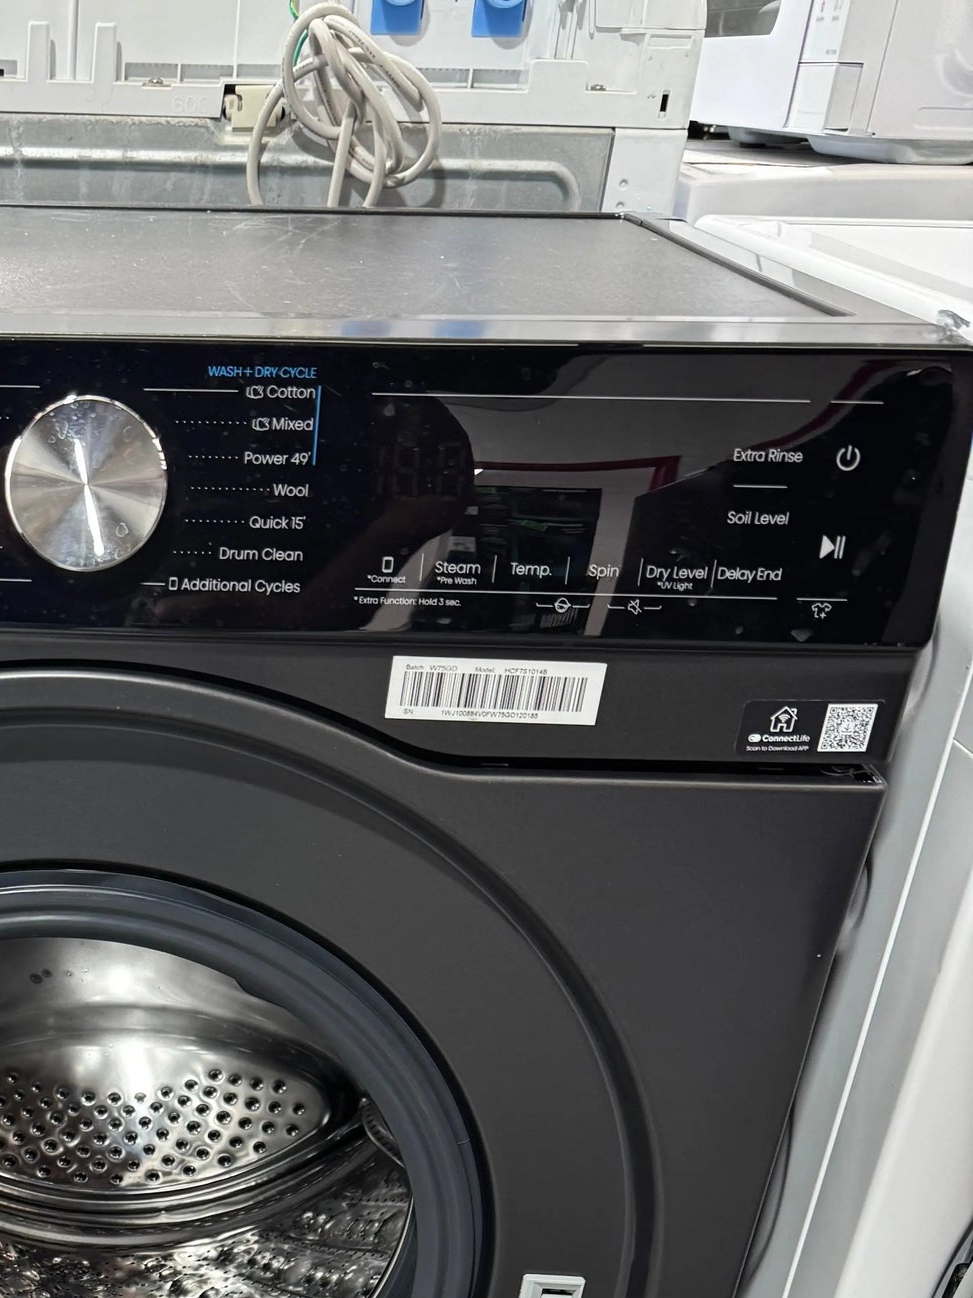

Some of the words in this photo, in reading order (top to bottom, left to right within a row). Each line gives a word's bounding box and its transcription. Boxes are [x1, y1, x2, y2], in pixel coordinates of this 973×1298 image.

[280, 367, 318, 379] CYCLE
[267, 385, 316, 399] Cotton
[272, 418, 314, 431] Mixed
[244, 452, 289, 465] Power
[733, 448, 765, 462] Extra
[768, 449, 803, 463] Rinse
[273, 483, 309, 497] Wool
[249, 516, 288, 530] Quick
[727, 511, 751, 525] Soil
[754, 512, 790, 526] Level
[219, 546, 259, 561] Drum
[262, 547, 304, 562] Clean
[435, 560, 481, 575] Steam
[510, 562, 552, 579] Temp.
[588, 564, 620, 580] Spin
[646, 565, 670, 581] Dry
[673, 566, 708, 580] Level
[454, 577, 477, 585] Wash
[717, 567, 756, 584] Delay
[757, 568, 783, 581] End
[181, 578, 252, 592] Additional
[254, 579, 301, 596] Cycles
[673, 581, 693, 592] Light
[418, 597, 437, 606] Hold
[438, 598, 444, 606] 3
[762, 734, 811, 743] ConnectLife
